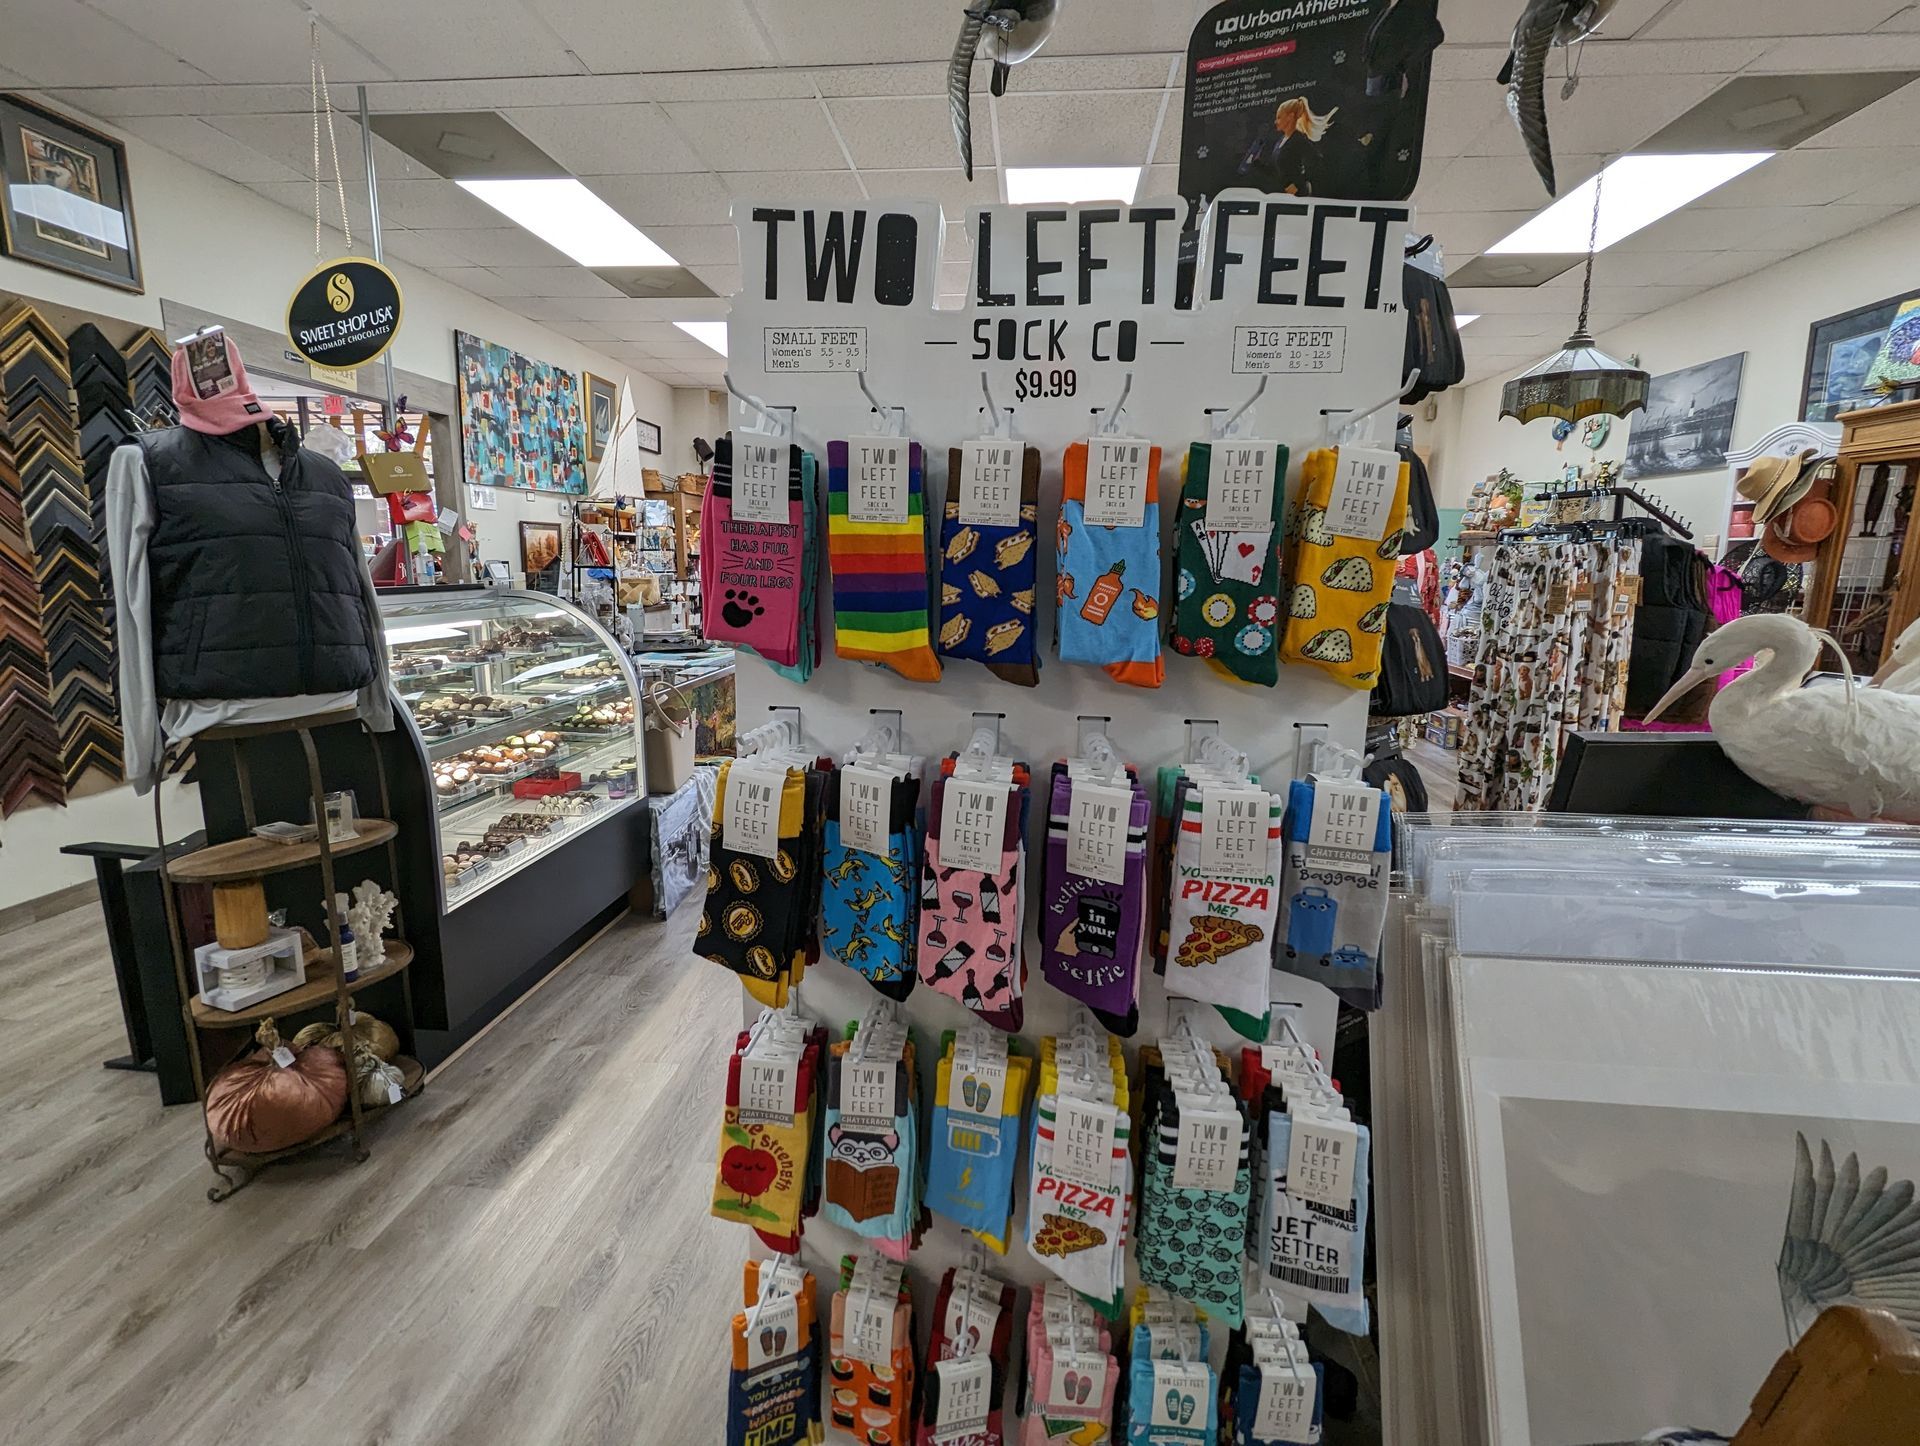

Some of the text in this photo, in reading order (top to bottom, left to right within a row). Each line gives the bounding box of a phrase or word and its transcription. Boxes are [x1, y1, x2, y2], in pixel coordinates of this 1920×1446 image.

[1215, 7, 1369, 48] High Rise Leggings Pants with Pockets
[752, 207, 919, 307] TWO
[977, 207, 1175, 308] LEFT
[1209, 200, 1409, 310] FEET
[300, 322, 336, 345] SWEET
[337, 313, 368, 336] SHOP
[308, 325, 390, 354] HANDMADE CHOCOLATES
[772, 332, 858, 345] SMALL FEET
[972, 319, 1138, 363] SOCK CO
[1246, 331, 1333, 347] BIG FEET
[771, 347, 860, 357] Women's 5.5 9.5
[1246, 350, 1332, 359] Women's 10 12.5
[771, 359, 851, 369] Men's 5 8
[1245, 360, 1324, 370] Men's 8.5 13
[1015, 367, 1077, 401] $9.99
[743, 445, 778, 464] TWO
[861, 448, 897, 464] TWO
[976, 449, 1011, 465] TWO
[1102, 446, 1139, 463] TWO
[1225, 450, 1264, 466] TWO
[744, 463, 777, 480] LEFT
[861, 467, 896, 481] LEFT
[975, 467, 1011, 483] LEFT
[1100, 465, 1138, 480] LEFT
[1223, 470, 1263, 484] LEFT
[1351, 460, 1387, 480] TWO
[744, 482, 777, 499] FEET
[861, 486, 896, 500] FEET
[973, 486, 1010, 501] FEET
[1099, 484, 1136, 500] FEET
[1222, 488, 1262, 504] FEET
[1346, 479, 1384, 497] LEFT
[1341, 497, 1380, 516] FEET
[721, 521, 799, 538] THERAPIST
[730, 539, 789, 556] HAS FUR
[744, 557, 774, 571] AND
[721, 572, 794, 589] FOUR LEGS
[738, 781, 771, 802] TWO
[849, 782, 879, 801] TWO
[735, 799, 769, 818] LEFT
[849, 799, 879, 817] LEFT
[958, 791, 994, 811] TWO
[1217, 799, 1256, 818] TWO
[1330, 793, 1368, 812] TWO
[955, 810, 993, 829] LEFT
[1081, 801, 1117, 822] TWO
[1327, 811, 1367, 828] LEFT
[734, 816, 768, 835] FEET
[849, 815, 878, 833] FEET
[1080, 820, 1115, 839] LEFT
[1217, 819, 1257, 834] LEFT
[954, 828, 991, 847] FEET
[1215, 837, 1256, 852] FEET
[1324, 829, 1365, 846] FEET
[1078, 838, 1114, 857] FEET
[1310, 847, 1370, 862] CHATTERBOX
[1300, 868, 1379, 889] Baggage
[1181, 879, 1269, 911] PIZZA
[1088, 909, 1106, 925] in
[1208, 902, 1239, 918] ME?
[1077, 922, 1116, 939] your
[1059, 961, 1125, 987] selfie
[752, 1067, 785, 1083] TWO
[852, 1069, 885, 1084] TWO
[751, 1083, 784, 1097] LEFT
[852, 1085, 885, 1099] LEFT
[750, 1097, 783, 1111] FEET
[851, 1101, 884, 1113] FEET
[1069, 1111, 1104, 1133] TWO
[1068, 1129, 1103, 1149] LEFT
[1192, 1123, 1228, 1140] TWO
[1190, 1141, 1227, 1156] LEFT
[1303, 1134, 1341, 1155] TWO
[760, 1133, 794, 1192] strength
[1067, 1144, 1101, 1164] FEET
[1301, 1151, 1340, 1171] LEFT
[1188, 1157, 1225, 1171] FEET
[1300, 1166, 1338, 1186] FEET
[1036, 1177, 1115, 1218] PIZZA
[1059, 1203, 1087, 1221] ME?
[1272, 1216, 1317, 1240] JET
[1311, 1213, 1359, 1233] ARRIVALS
[1270, 1235, 1339, 1266] SETTER
[1273, 1253, 1339, 1275] FIRST CLASS
[952, 1376, 981, 1395] TWO
[749, 1390, 769, 1403] YOU
[949, 1391, 981, 1408] LEFT
[749, 1402, 795, 1430] WASTED
[948, 1405, 980, 1421] FEET
[746, 1417, 793, 1446] TIME
